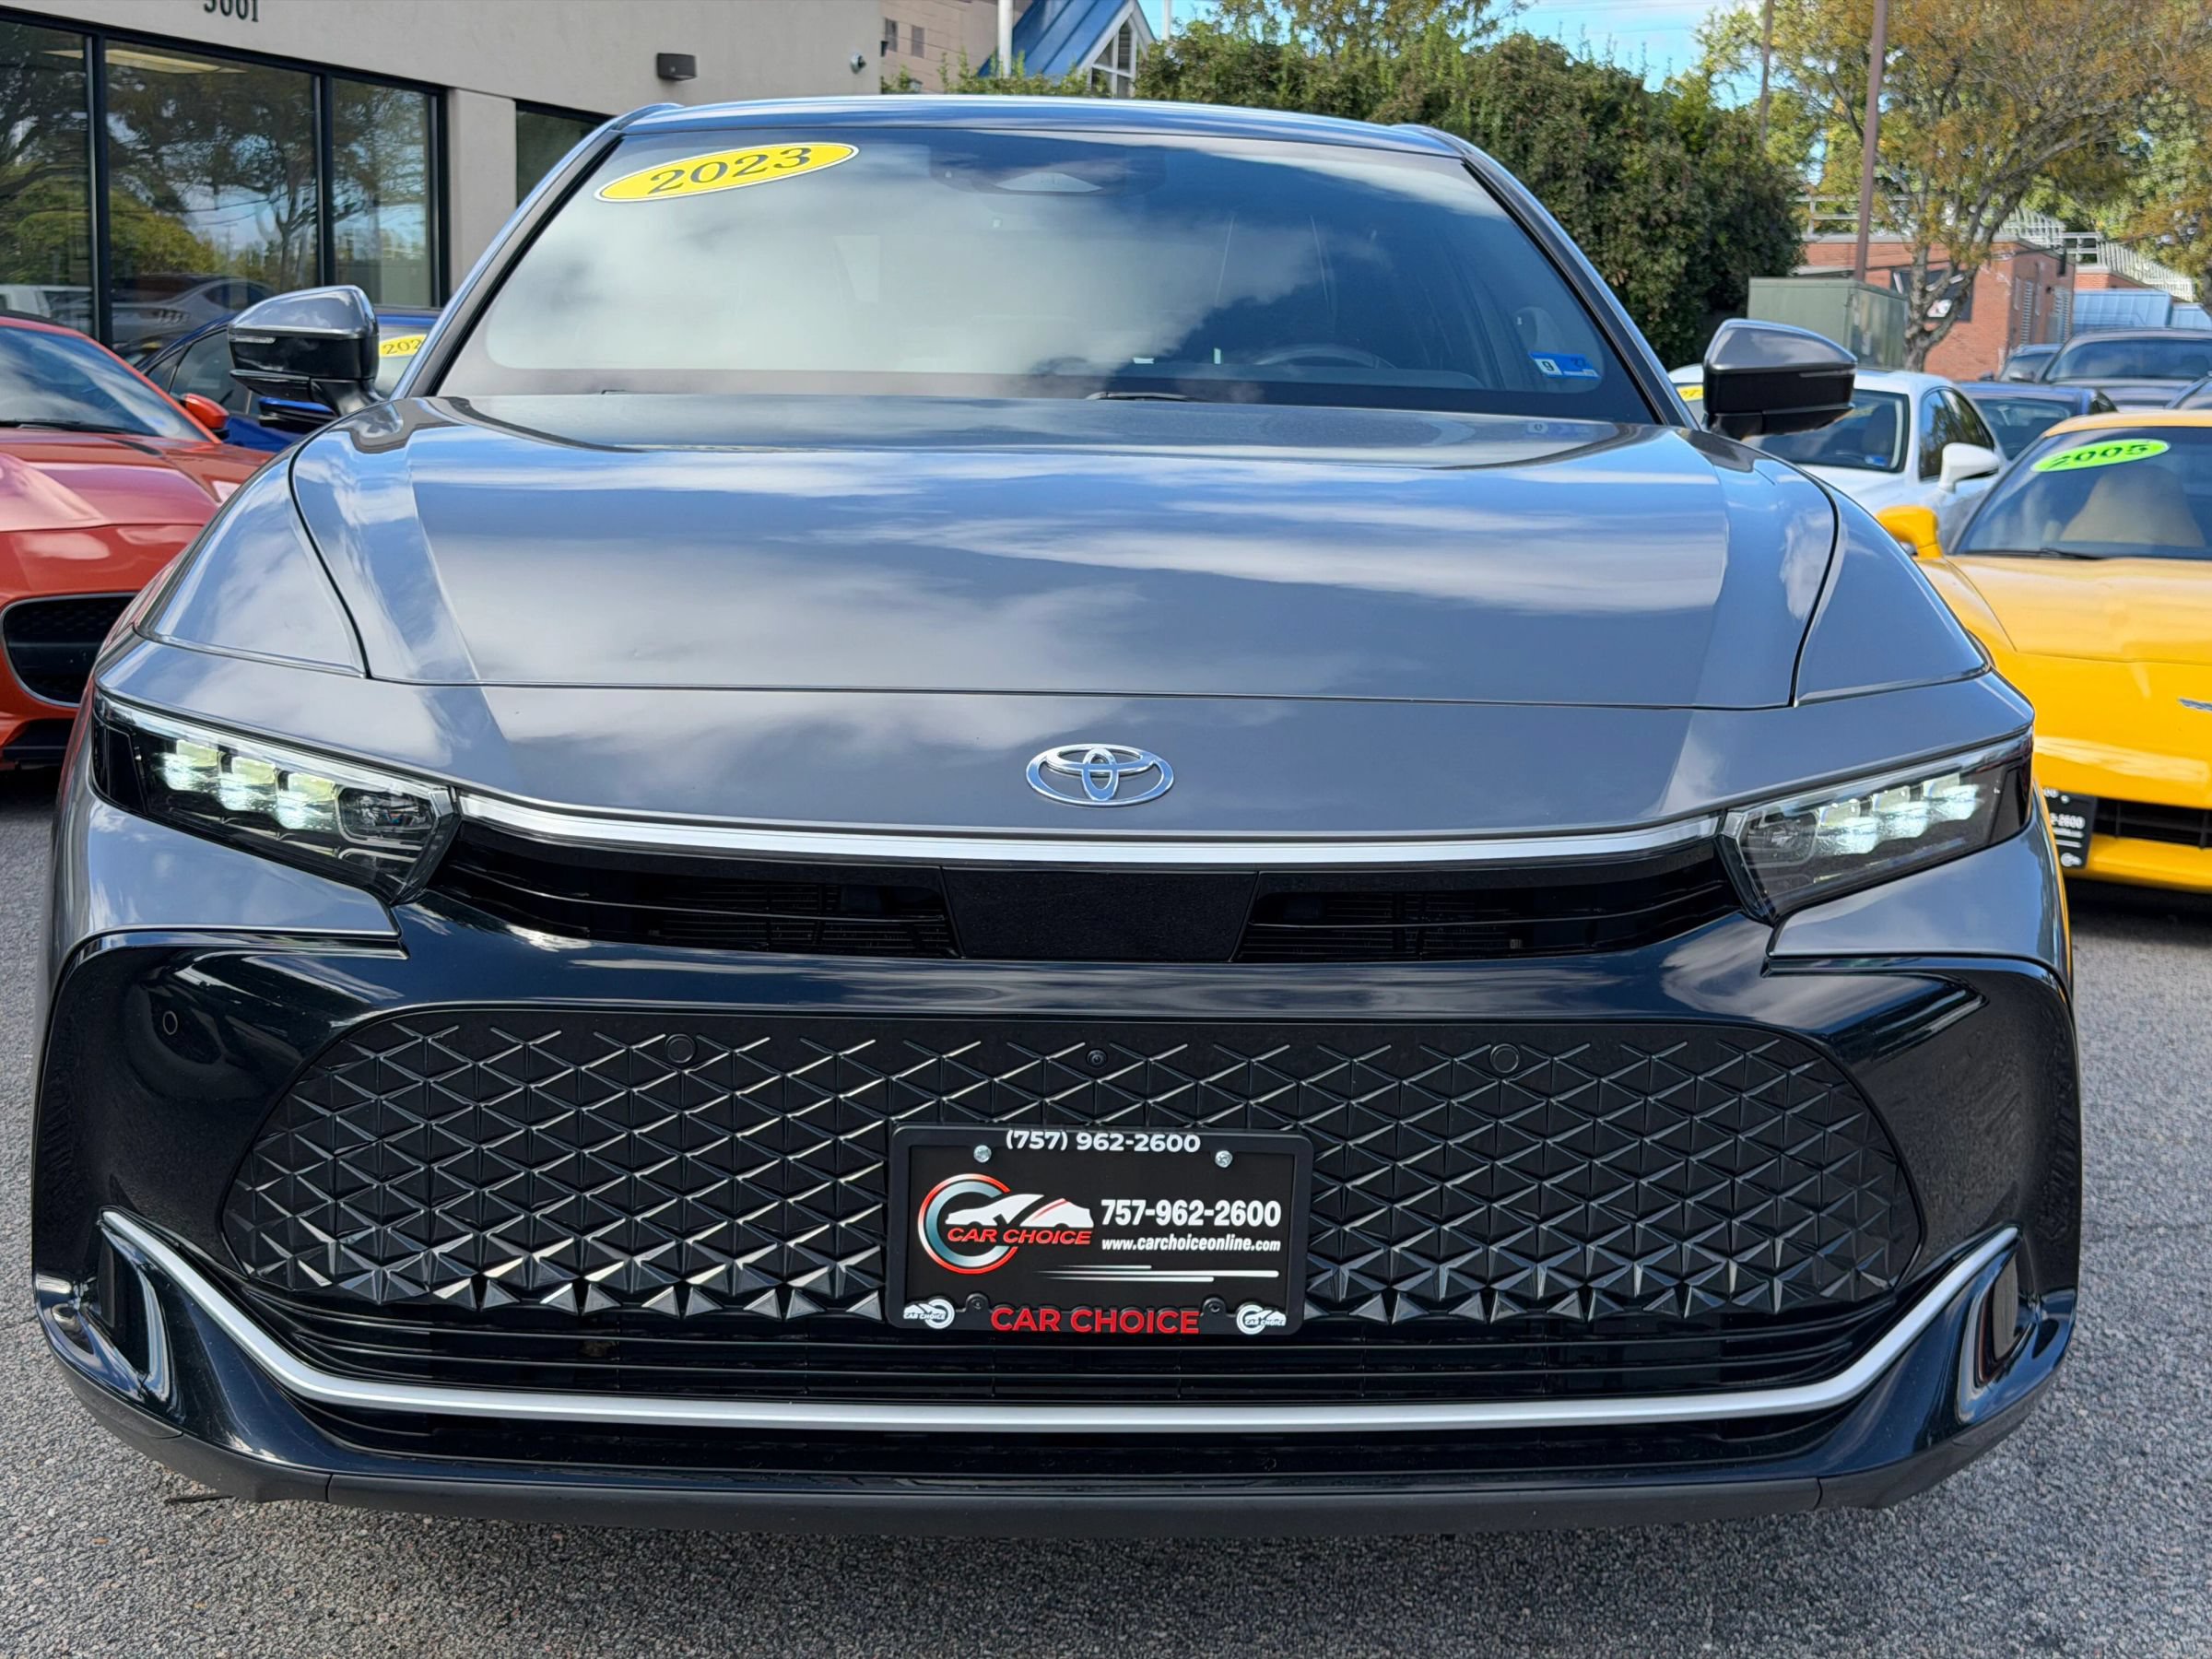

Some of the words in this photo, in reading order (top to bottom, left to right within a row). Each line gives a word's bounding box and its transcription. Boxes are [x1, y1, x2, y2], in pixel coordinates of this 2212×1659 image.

[647, 147, 812, 194] 2023
[1542, 360, 1556, 371] 9
[2044, 444, 2151, 470] 2005
[1006, 1129, 1068, 1150] (757)
[1076, 1132, 1201, 1152] 962-2600
[1100, 1199, 1281, 1227] 757-962-2600
[947, 1227, 998, 1242] CAR
[1003, 1229, 1092, 1245] CHOICE
[1101, 1233, 1281, 1252] www.carchoiceonline.com
[990, 1307, 1060, 1332] CAR
[1070, 1309, 1201, 1335] CHOICE
